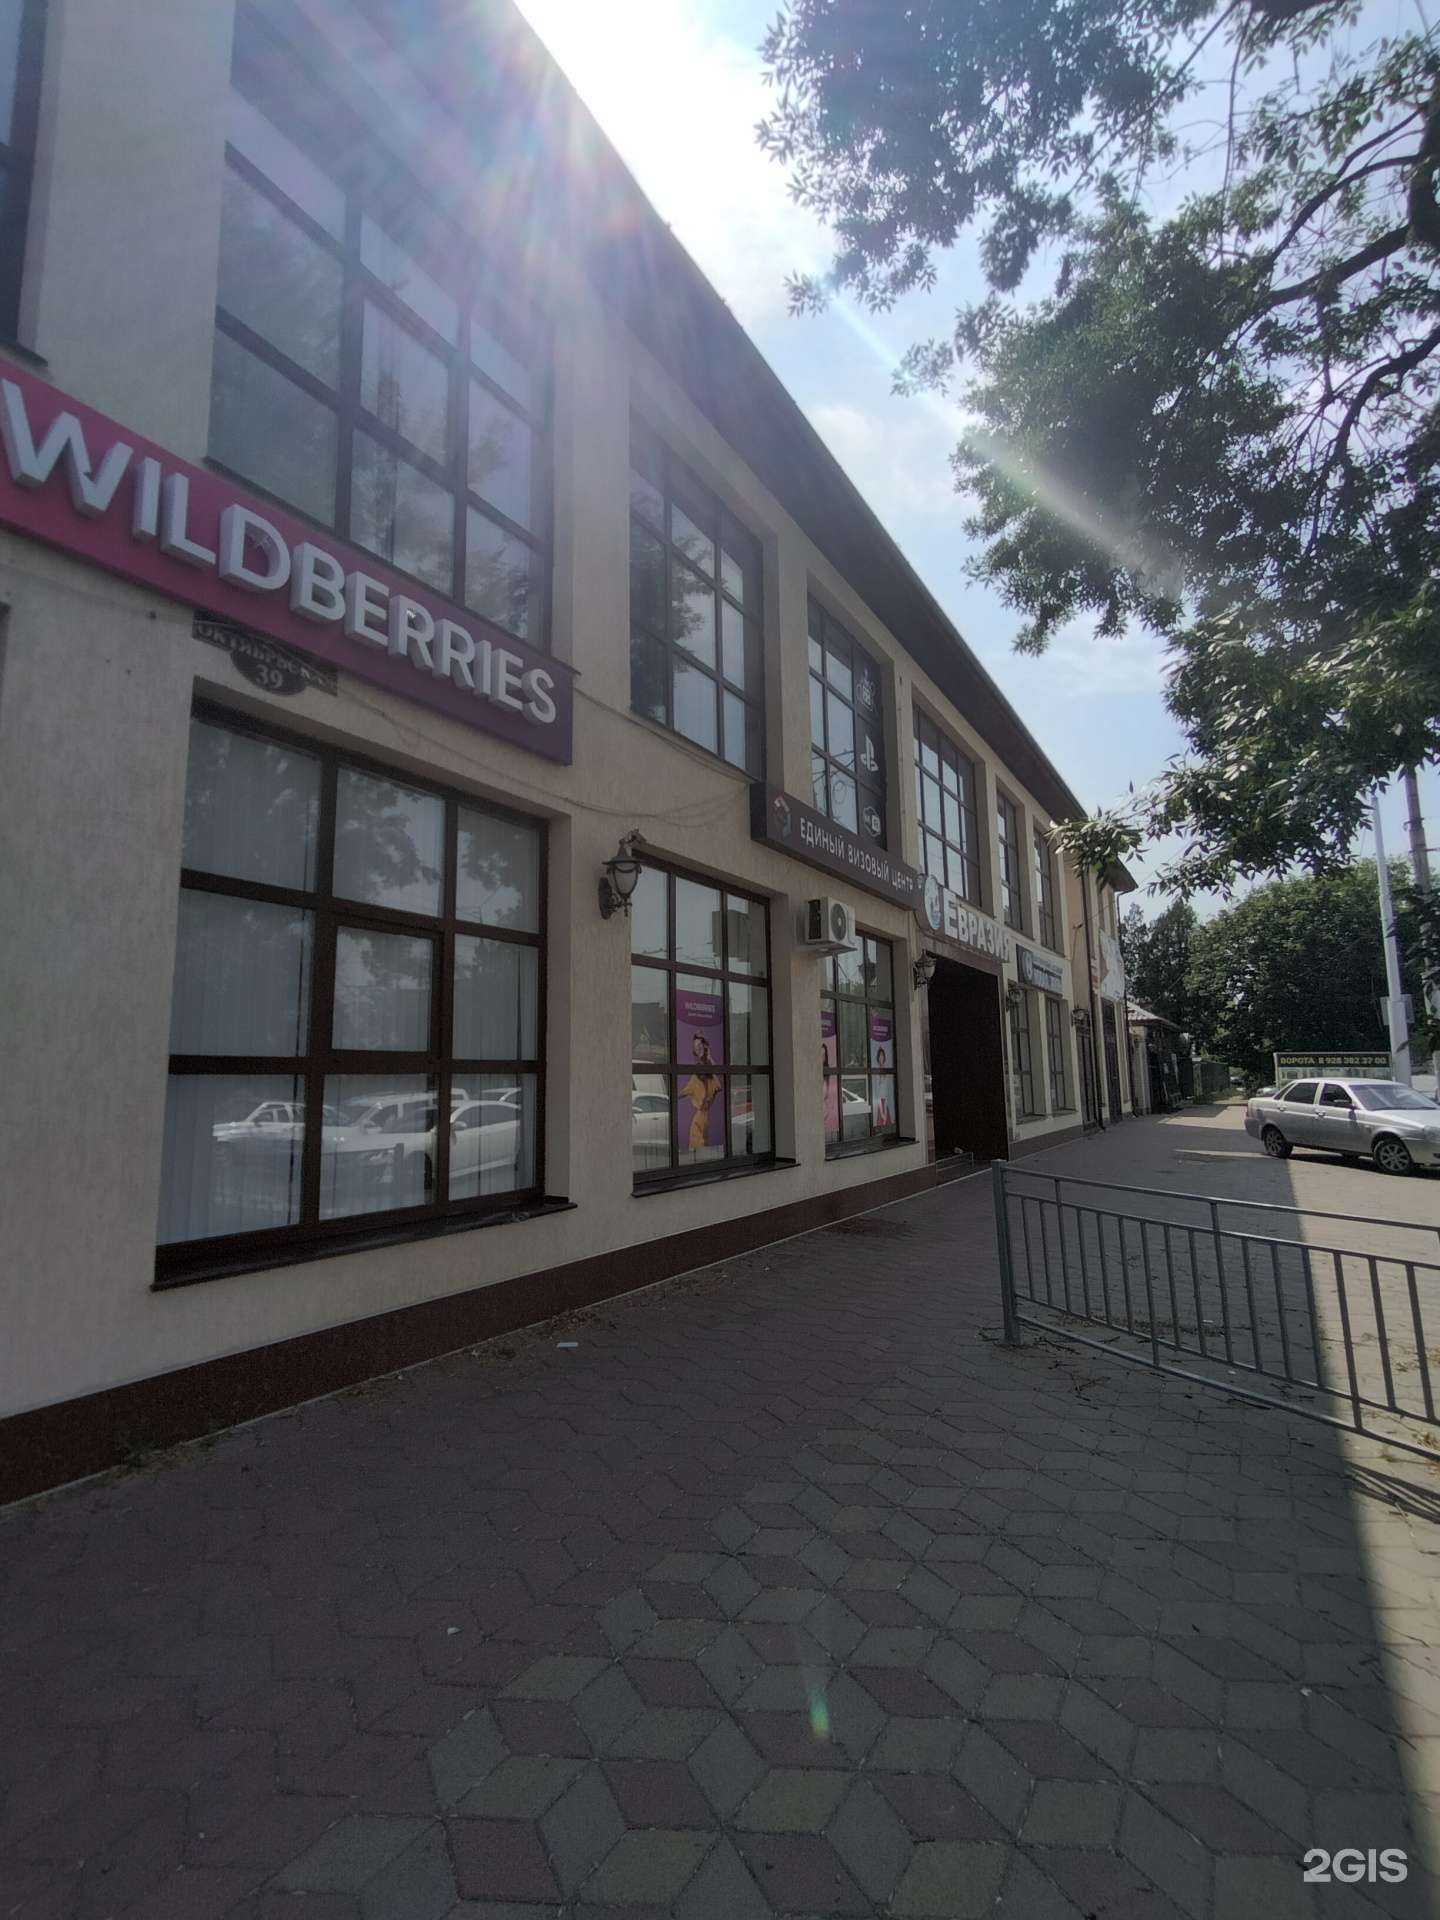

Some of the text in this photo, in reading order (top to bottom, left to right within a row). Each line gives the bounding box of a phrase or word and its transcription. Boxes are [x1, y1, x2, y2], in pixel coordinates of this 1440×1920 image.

[0, 378, 558, 725] WILDBERRIES
[255, 662, 284, 689] 39
[800, 817, 846, 860] ЕДИНЫЙ
[847, 843, 890, 881] ВИЗОВЫЙ
[891, 868, 914, 893] ЦЕНТР
[943, 888, 1010, 961] ЕВРАЗИЯ
